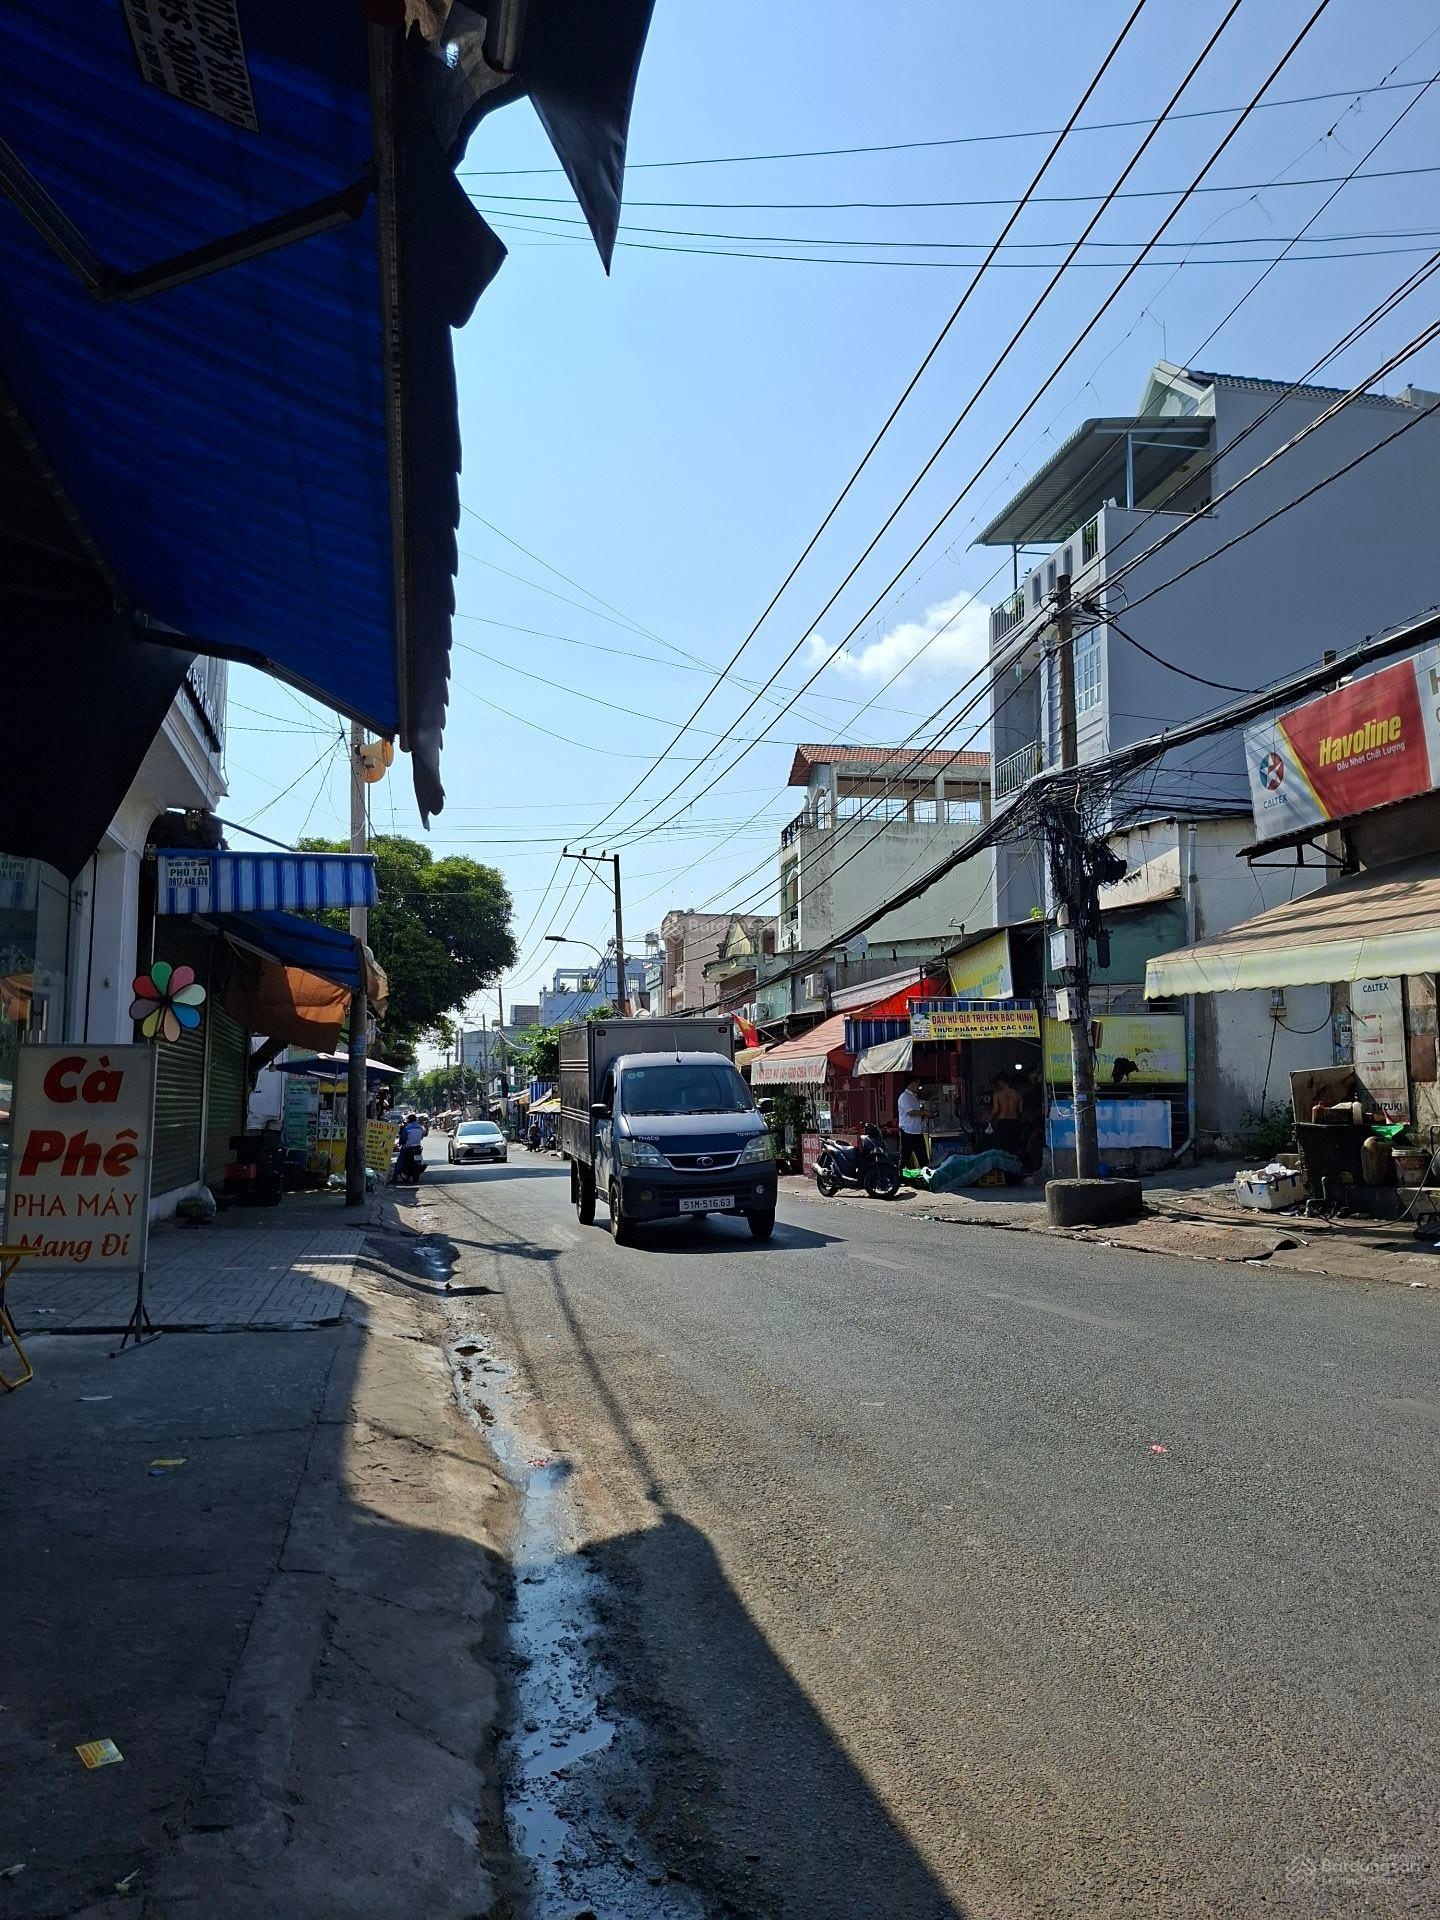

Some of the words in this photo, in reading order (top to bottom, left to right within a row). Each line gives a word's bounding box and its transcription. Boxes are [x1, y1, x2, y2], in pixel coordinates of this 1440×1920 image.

[1319, 716, 1401, 767] Havoline
[1263, 793, 1288, 809] CALTEX
[1362, 982, 1389, 993] CALTEX
[1017, 1012, 1033, 1021] NINH
[43, 1055, 124, 1104] Cà
[1371, 1102, 1402, 1111] SUZUKI
[19, 1128, 139, 1177] Phê
[13, 1193, 67, 1217] PHA
[77, 1187, 138, 1217] MÁY
[18, 1234, 93, 1263] Mang
[101, 1233, 131, 1257] Đi
